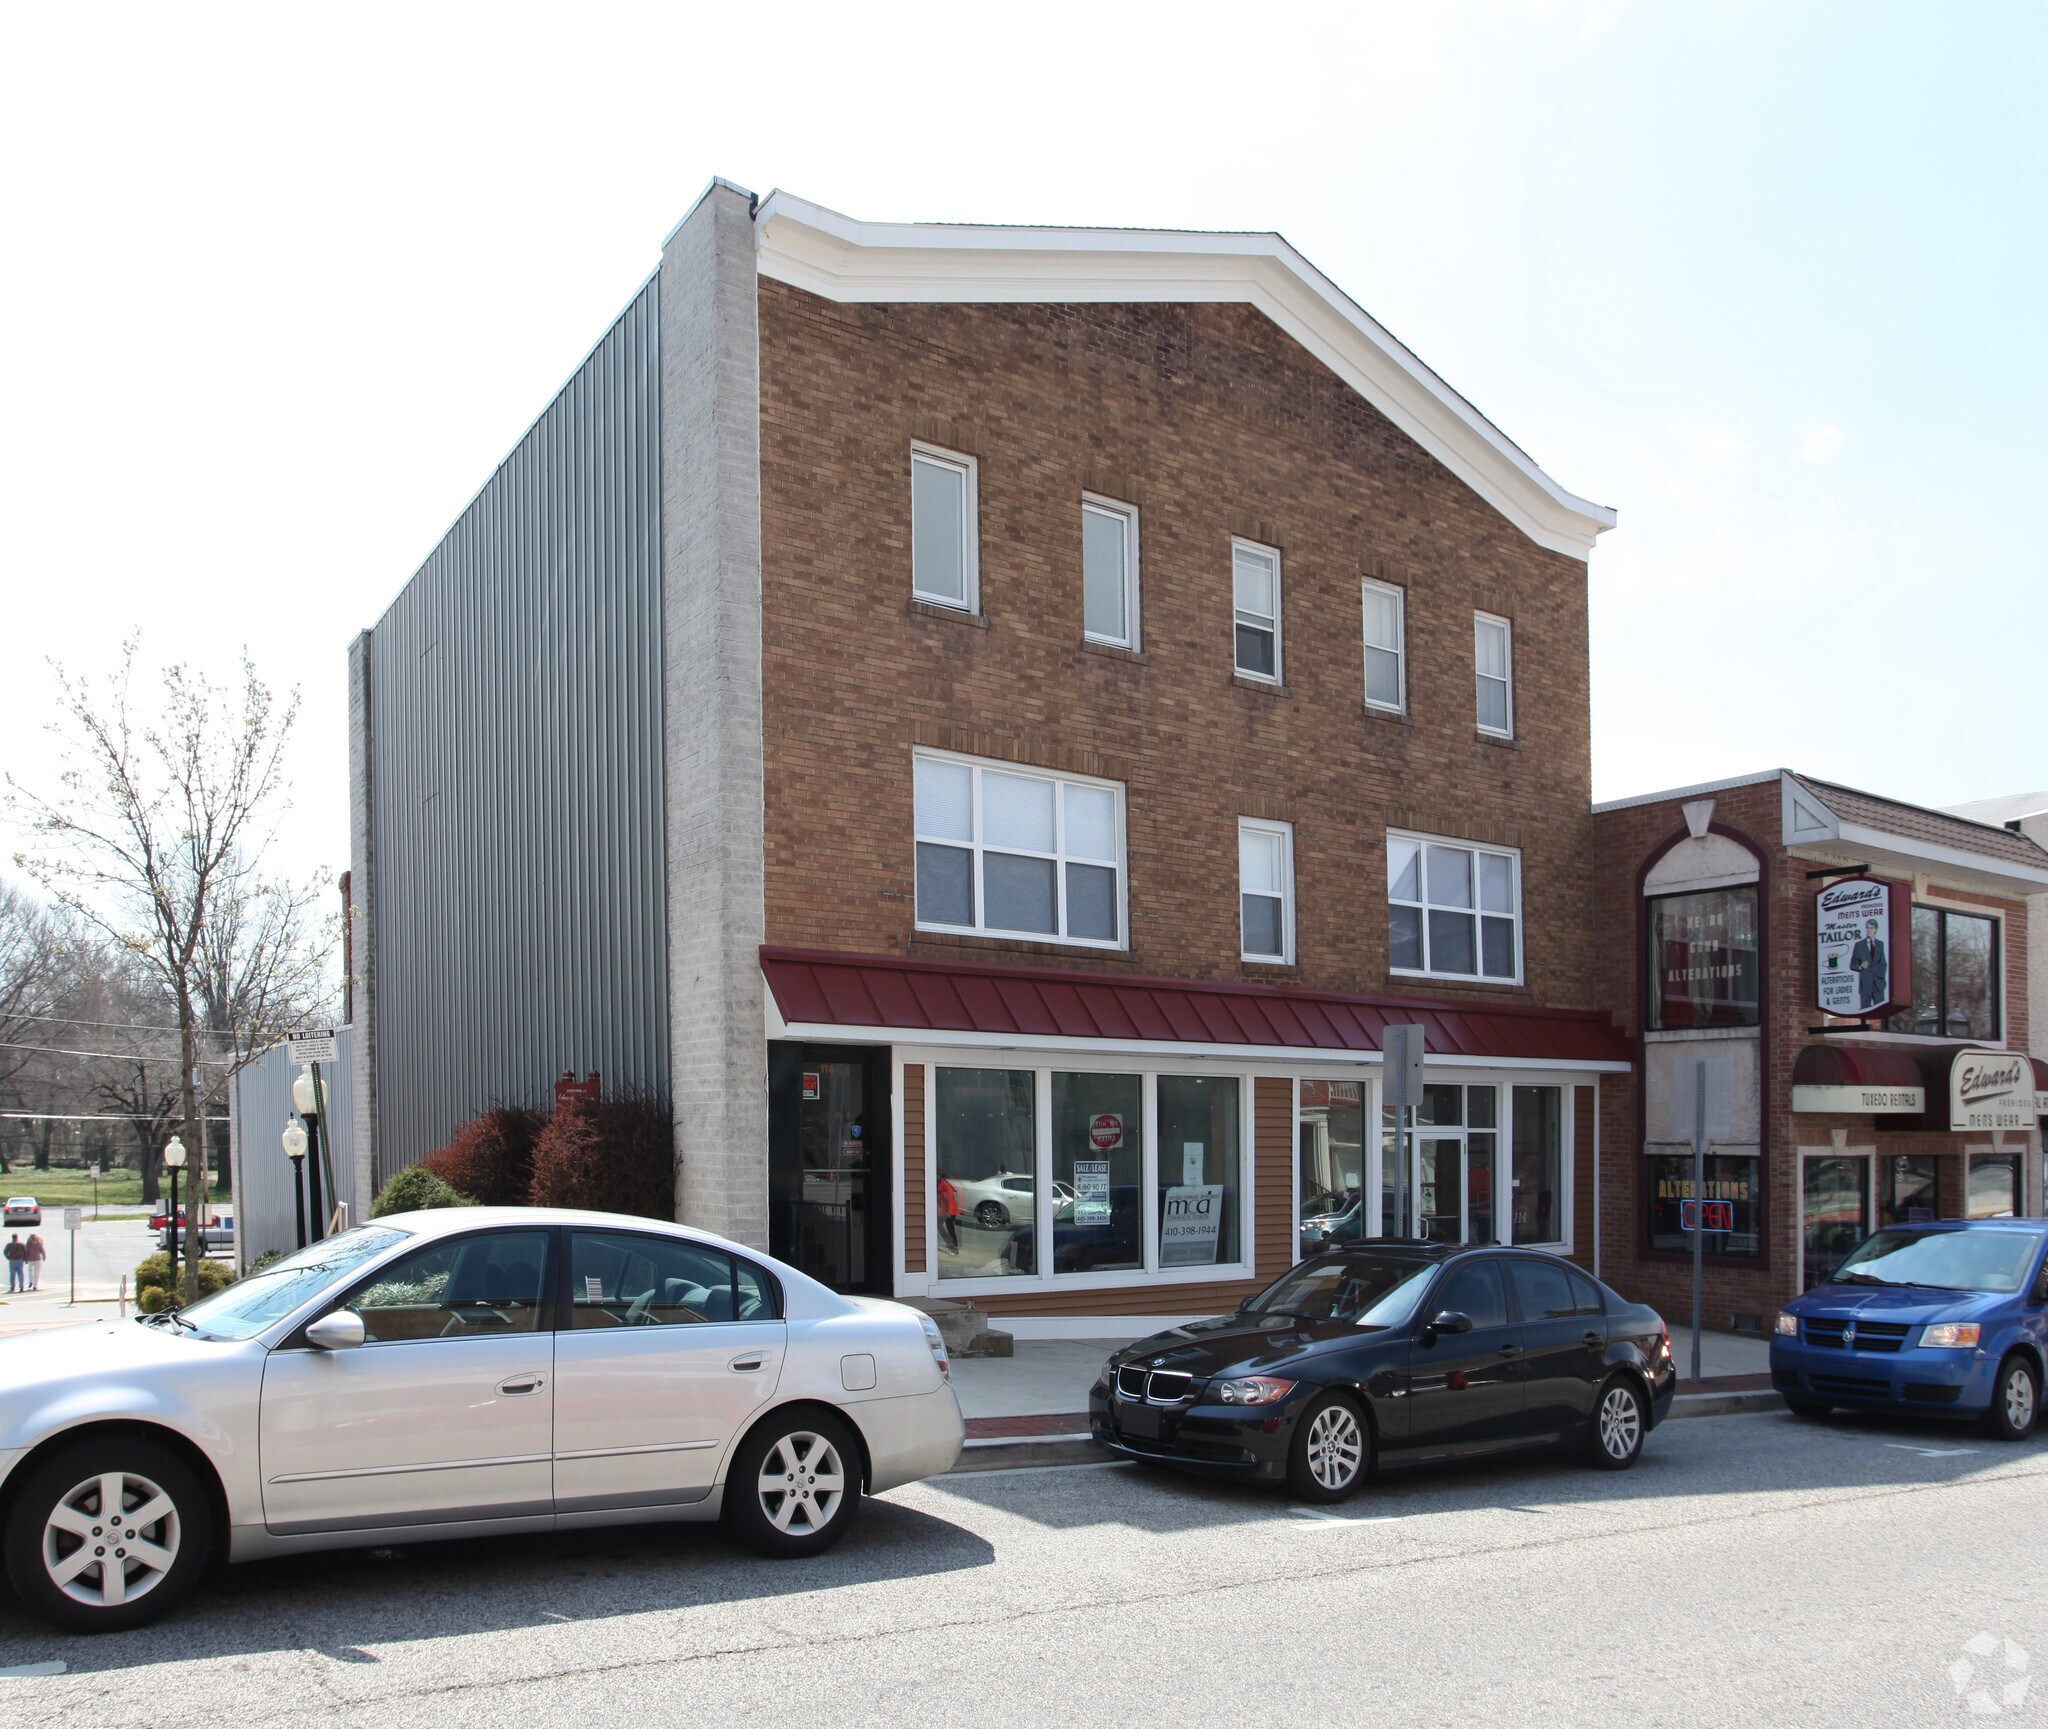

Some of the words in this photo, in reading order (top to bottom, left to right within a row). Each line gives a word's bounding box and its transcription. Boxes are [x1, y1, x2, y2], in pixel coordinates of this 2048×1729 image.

[1821, 885, 1881, 907] Edward's
[1838, 911, 1860, 920] MEN'S
[1862, 909, 1883, 917] WEAR
[1819, 929, 1862, 944] TAILOR
[1668, 964, 1742, 982] ALTERATIONS
[1821, 975, 1855, 985] ALTERATIONS
[1823, 987, 1834, 996] FOR
[1836, 985, 1853, 994] LADIES
[1826, 998, 1831, 1006] &
[1832, 996, 1851, 1006] GENTS
[302, 1030, 331, 1039] LOITERING
[1960, 1060, 2021, 1097] Edward's
[1862, 1092, 1888, 1107] TUXEDO
[1890, 1092, 1916, 1107] RENTALS
[1998, 1099, 2032, 1108] FASHIONS
[1969, 1114, 1993, 1127] MEN'S
[1996, 1114, 2020, 1127] WEAR
[1076, 1163, 1108, 1173] SALE/LEASE
[1092, 1183, 1100, 1191] SQ
[1167, 1190, 1211, 1215] mcd
[1683, 1203, 1731, 1229] OPEN
[1164, 1225, 1217, 1237] 410-398-1944
